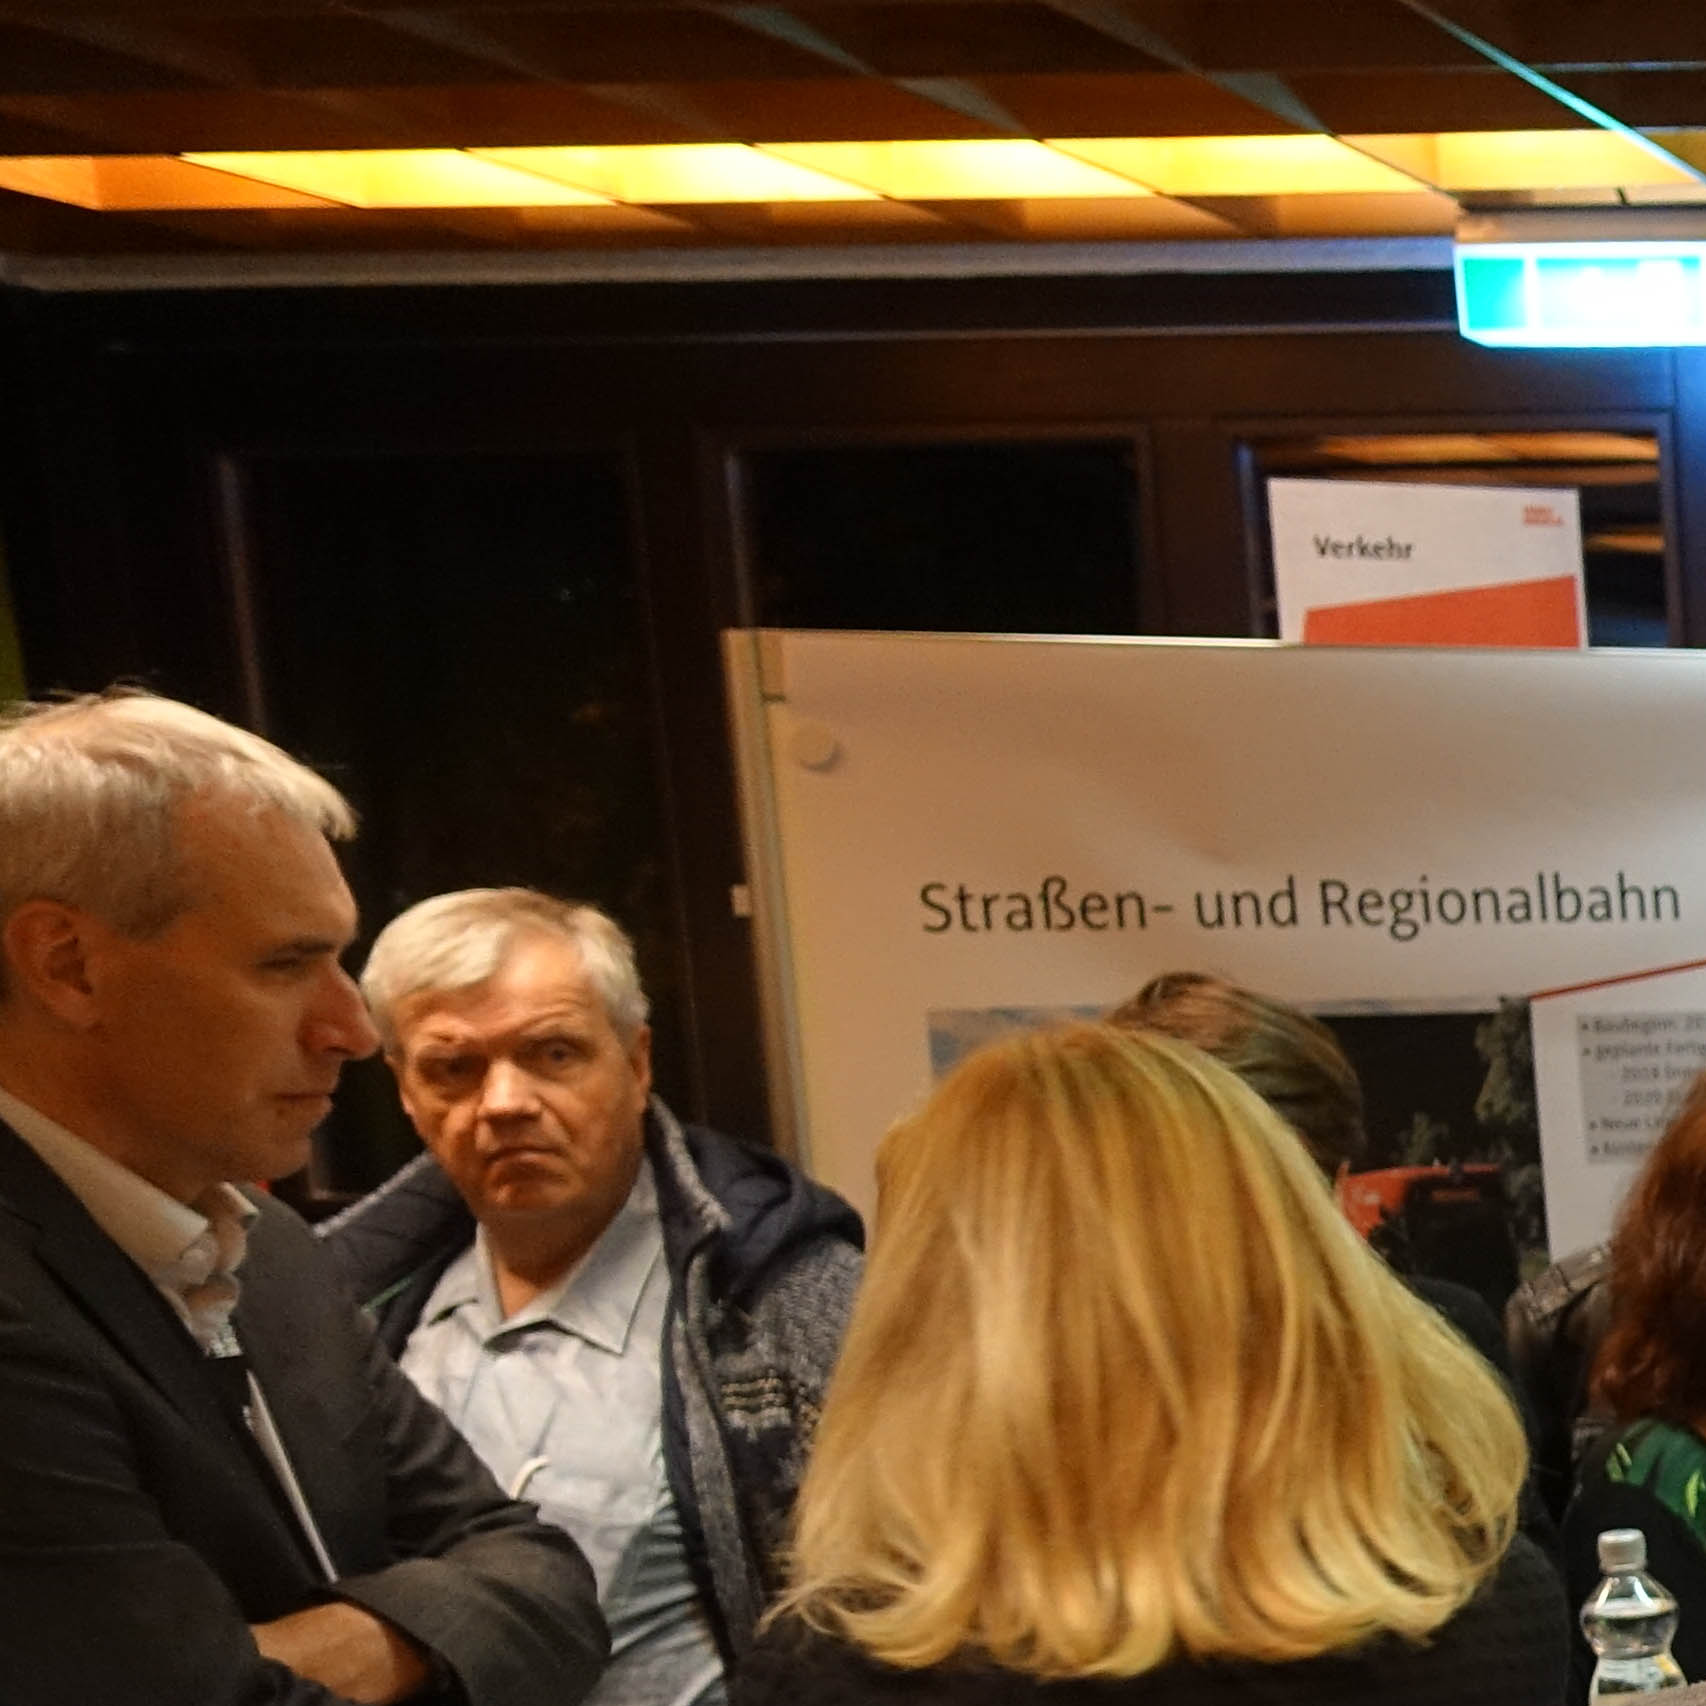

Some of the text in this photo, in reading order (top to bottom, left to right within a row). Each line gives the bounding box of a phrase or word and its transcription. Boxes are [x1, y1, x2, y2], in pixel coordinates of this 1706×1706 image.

[1313, 535, 1413, 559] Verkehr
[920, 870, 1681, 942] Straßen- und Regionalbahn
